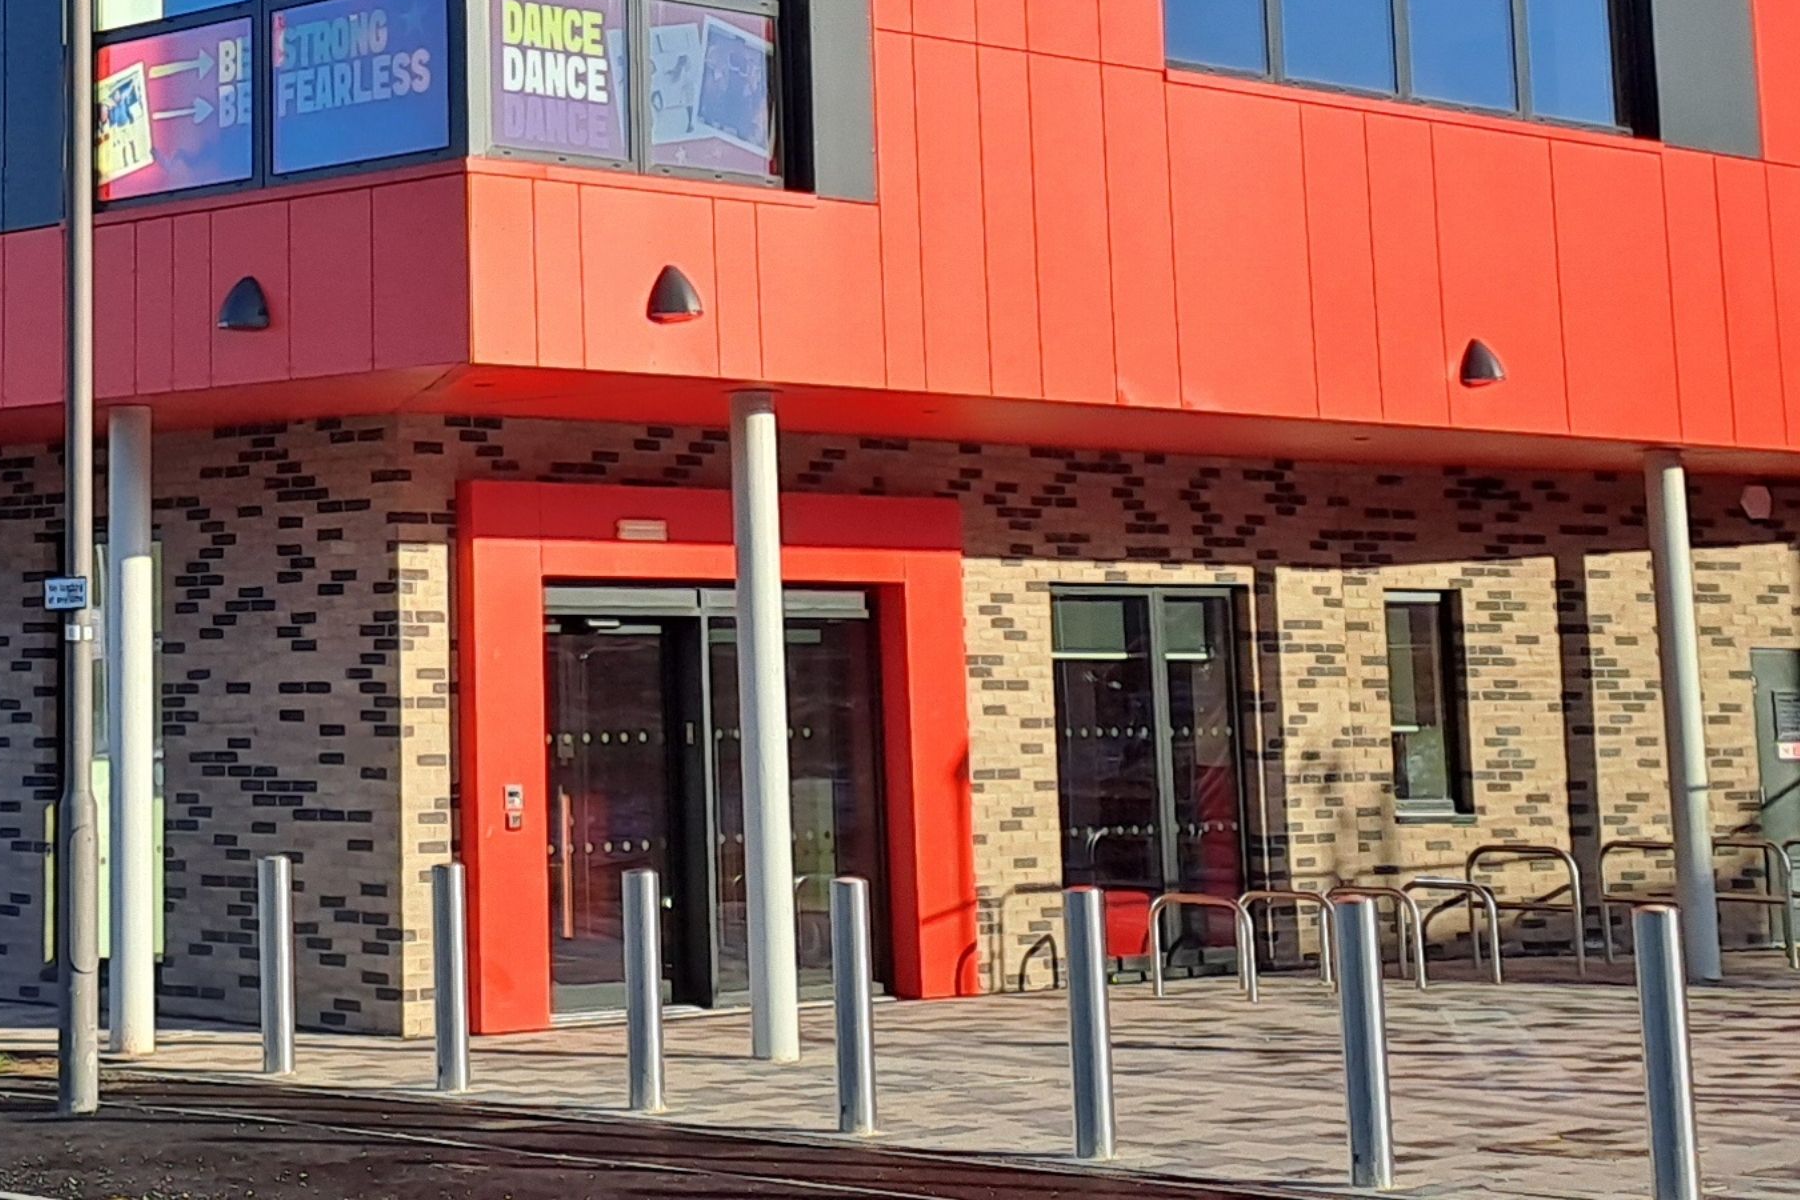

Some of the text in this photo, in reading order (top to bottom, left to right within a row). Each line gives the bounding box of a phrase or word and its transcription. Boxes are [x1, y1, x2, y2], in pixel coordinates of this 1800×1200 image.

[276, 9, 387, 69] STRONG
[218, 48, 431, 128] BE FEARLESS
[503, 45, 609, 104] DANCE
[503, 95, 609, 150] DANCE
